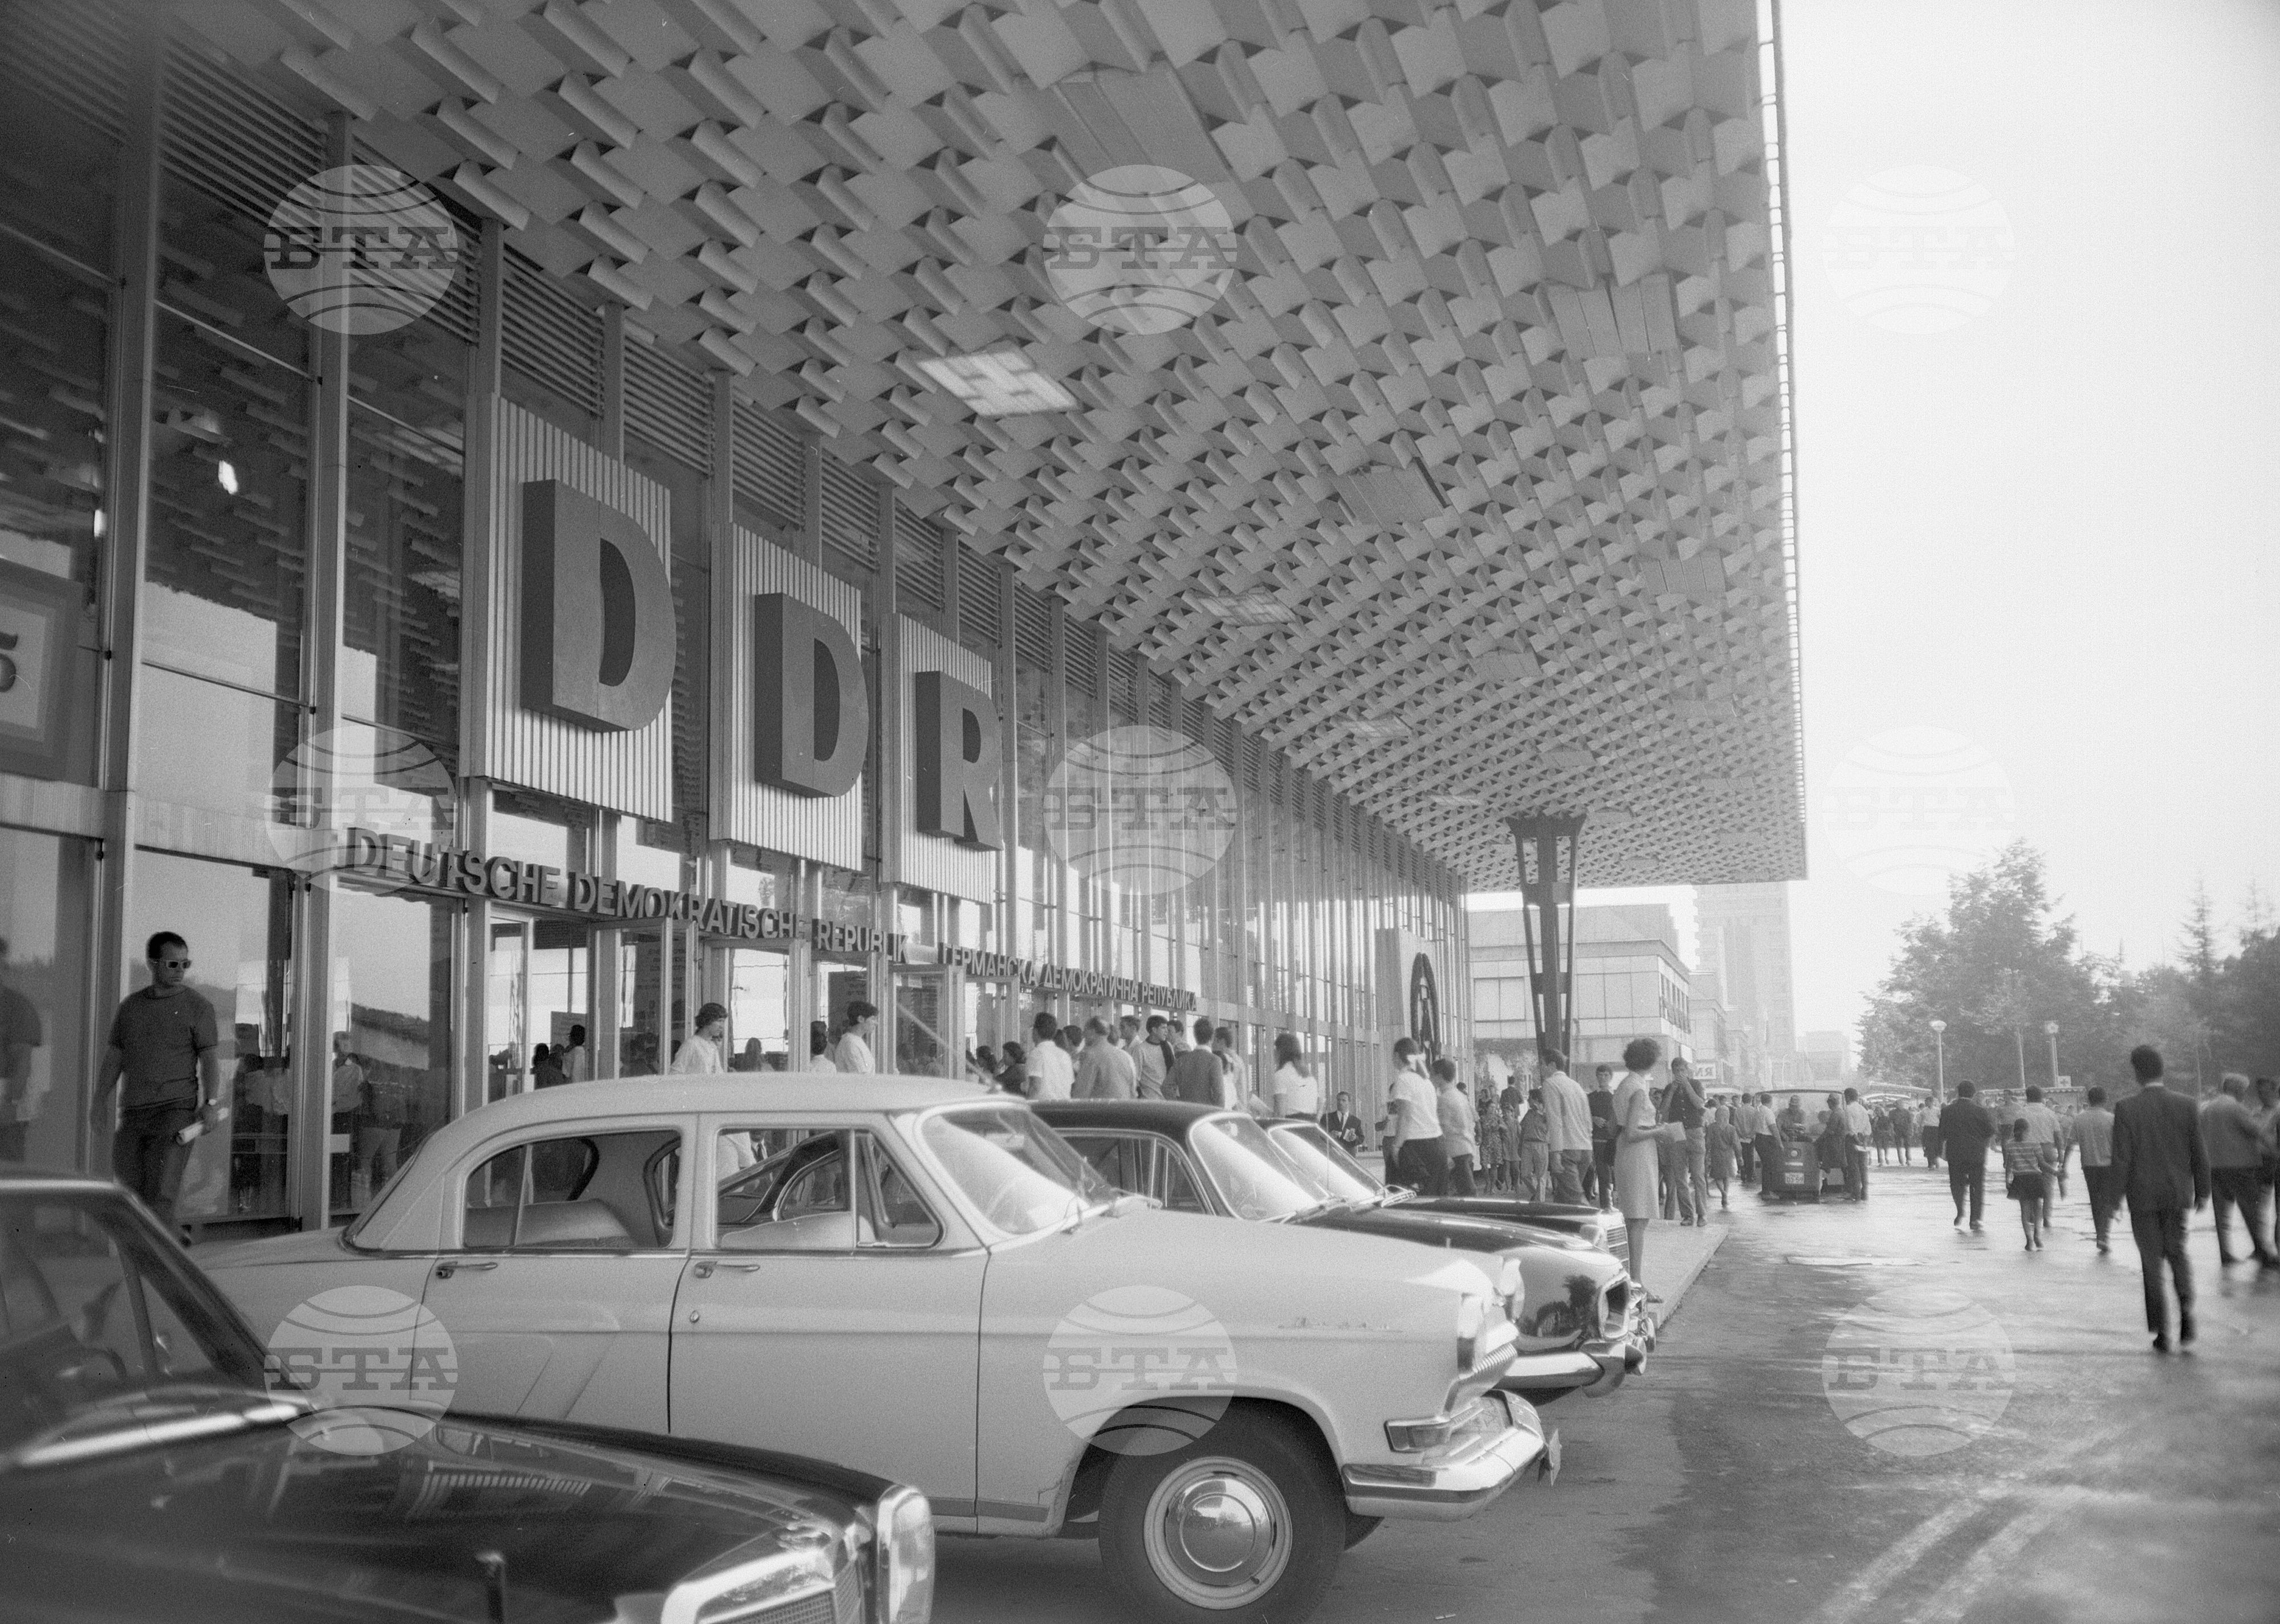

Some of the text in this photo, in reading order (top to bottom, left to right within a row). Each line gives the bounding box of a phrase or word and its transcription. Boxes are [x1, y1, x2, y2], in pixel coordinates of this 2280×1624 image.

[347, 827, 909, 963] DEUTSCHE DEMOKRATISCHE REPUBLIK
[942, 943, 1197, 1011] ГЕРМАНСКА ДЕМОКРАТИЧНА РЕПУБЛИКА
